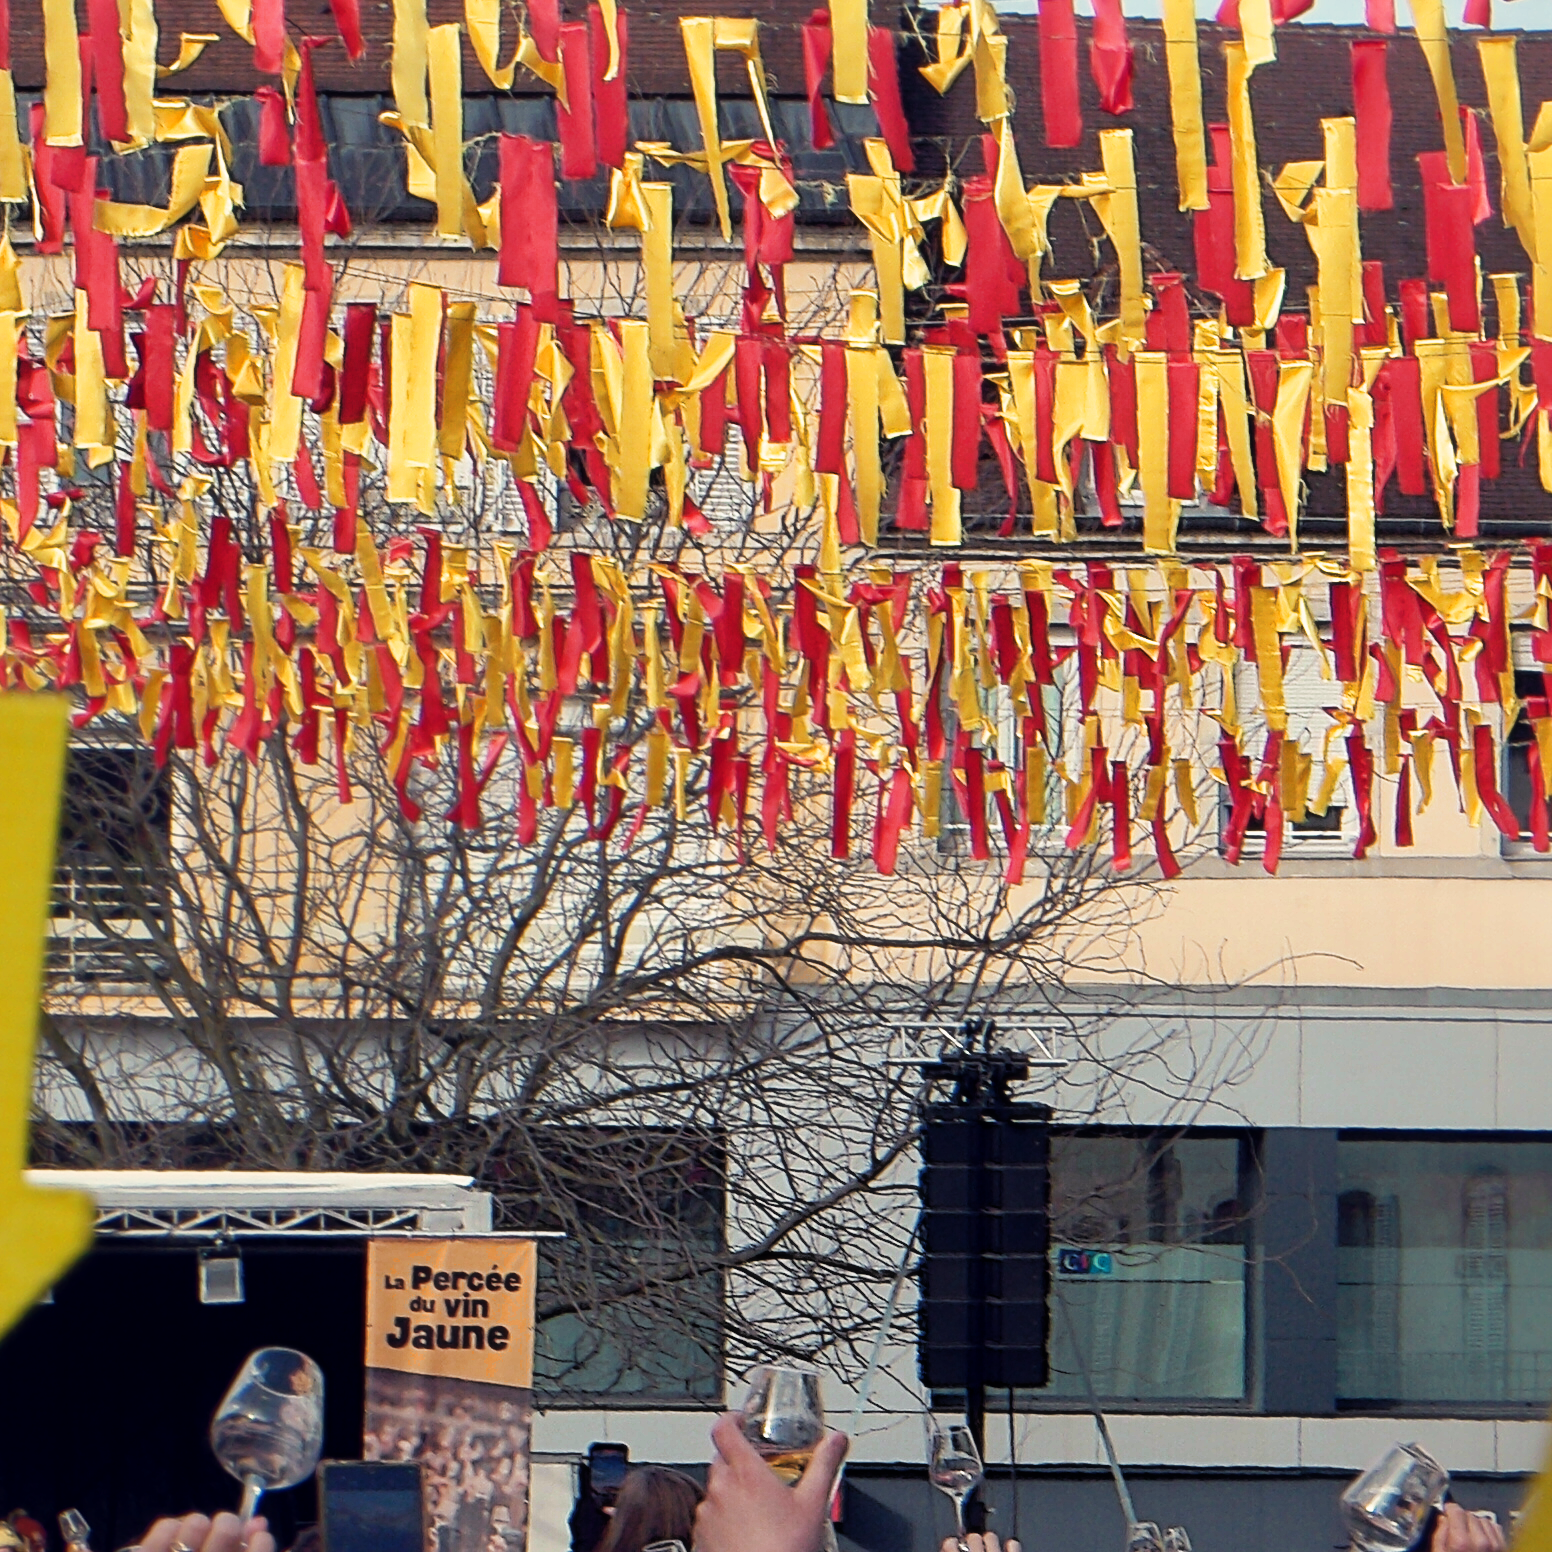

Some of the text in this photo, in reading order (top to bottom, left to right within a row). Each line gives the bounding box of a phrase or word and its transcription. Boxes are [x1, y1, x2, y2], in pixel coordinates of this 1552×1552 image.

[1062, 1252, 1110, 1271] CIC
[385, 1264, 522, 1292] La Percée
[410, 1292, 489, 1318] du vin
[386, 1317, 510, 1351] Jaune
